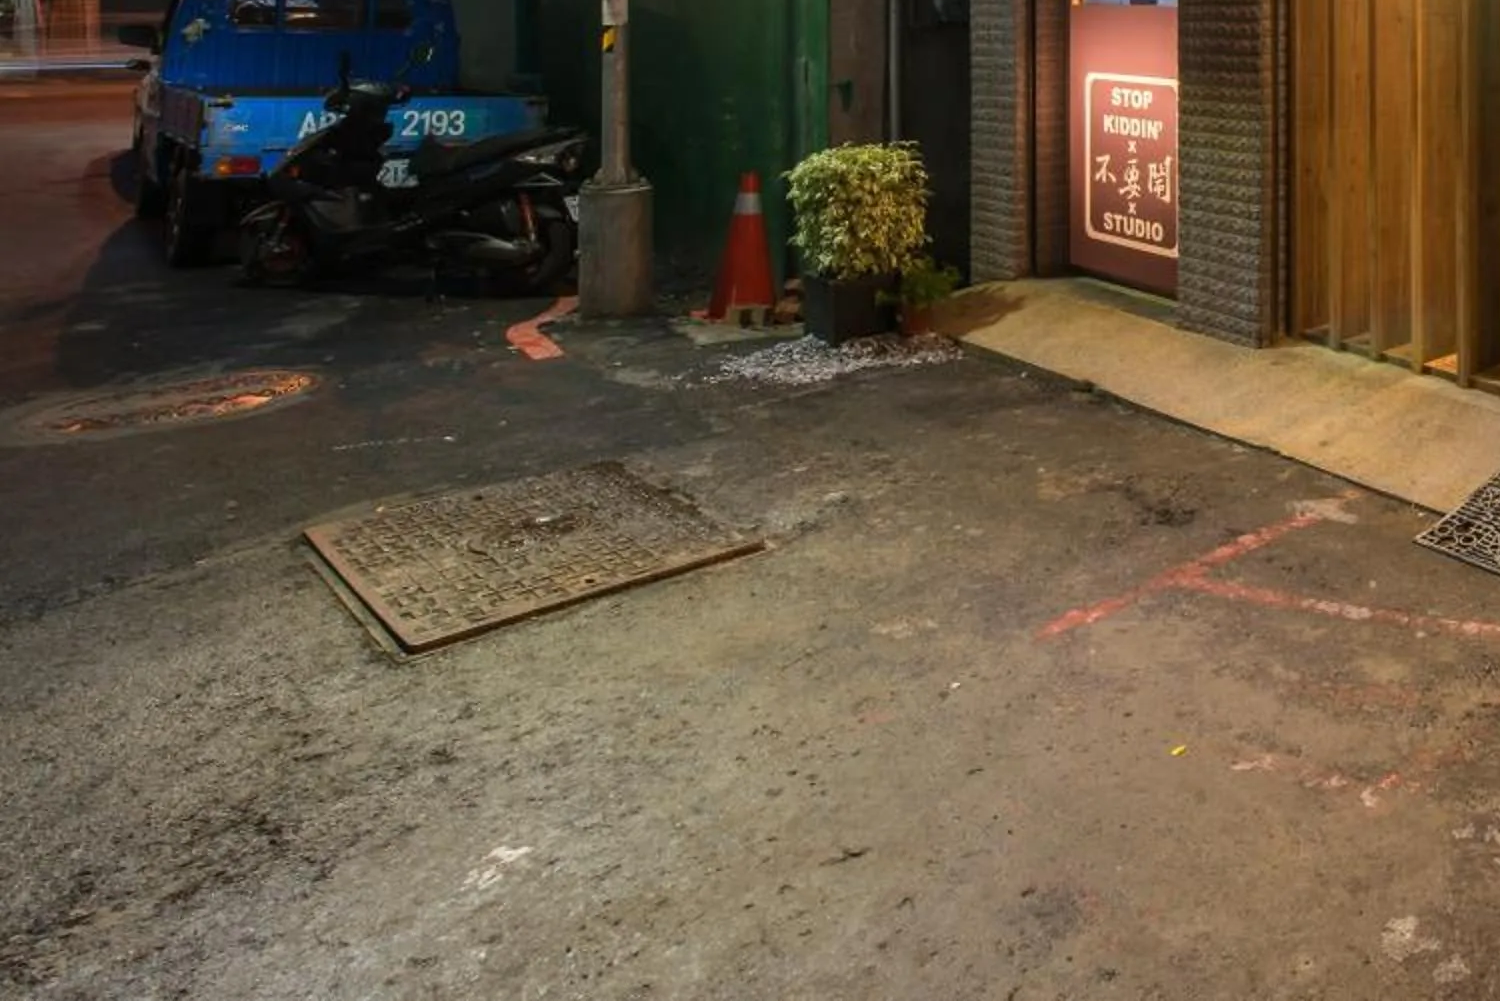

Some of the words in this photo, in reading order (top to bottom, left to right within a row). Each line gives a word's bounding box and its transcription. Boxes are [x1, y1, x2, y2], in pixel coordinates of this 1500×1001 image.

[1111, 86, 1153, 110] STOP
[401, 110, 465, 136] 2193
[1103, 113, 1164, 141] KIDDIN'
[1103, 212, 1164, 243] STUDIO
